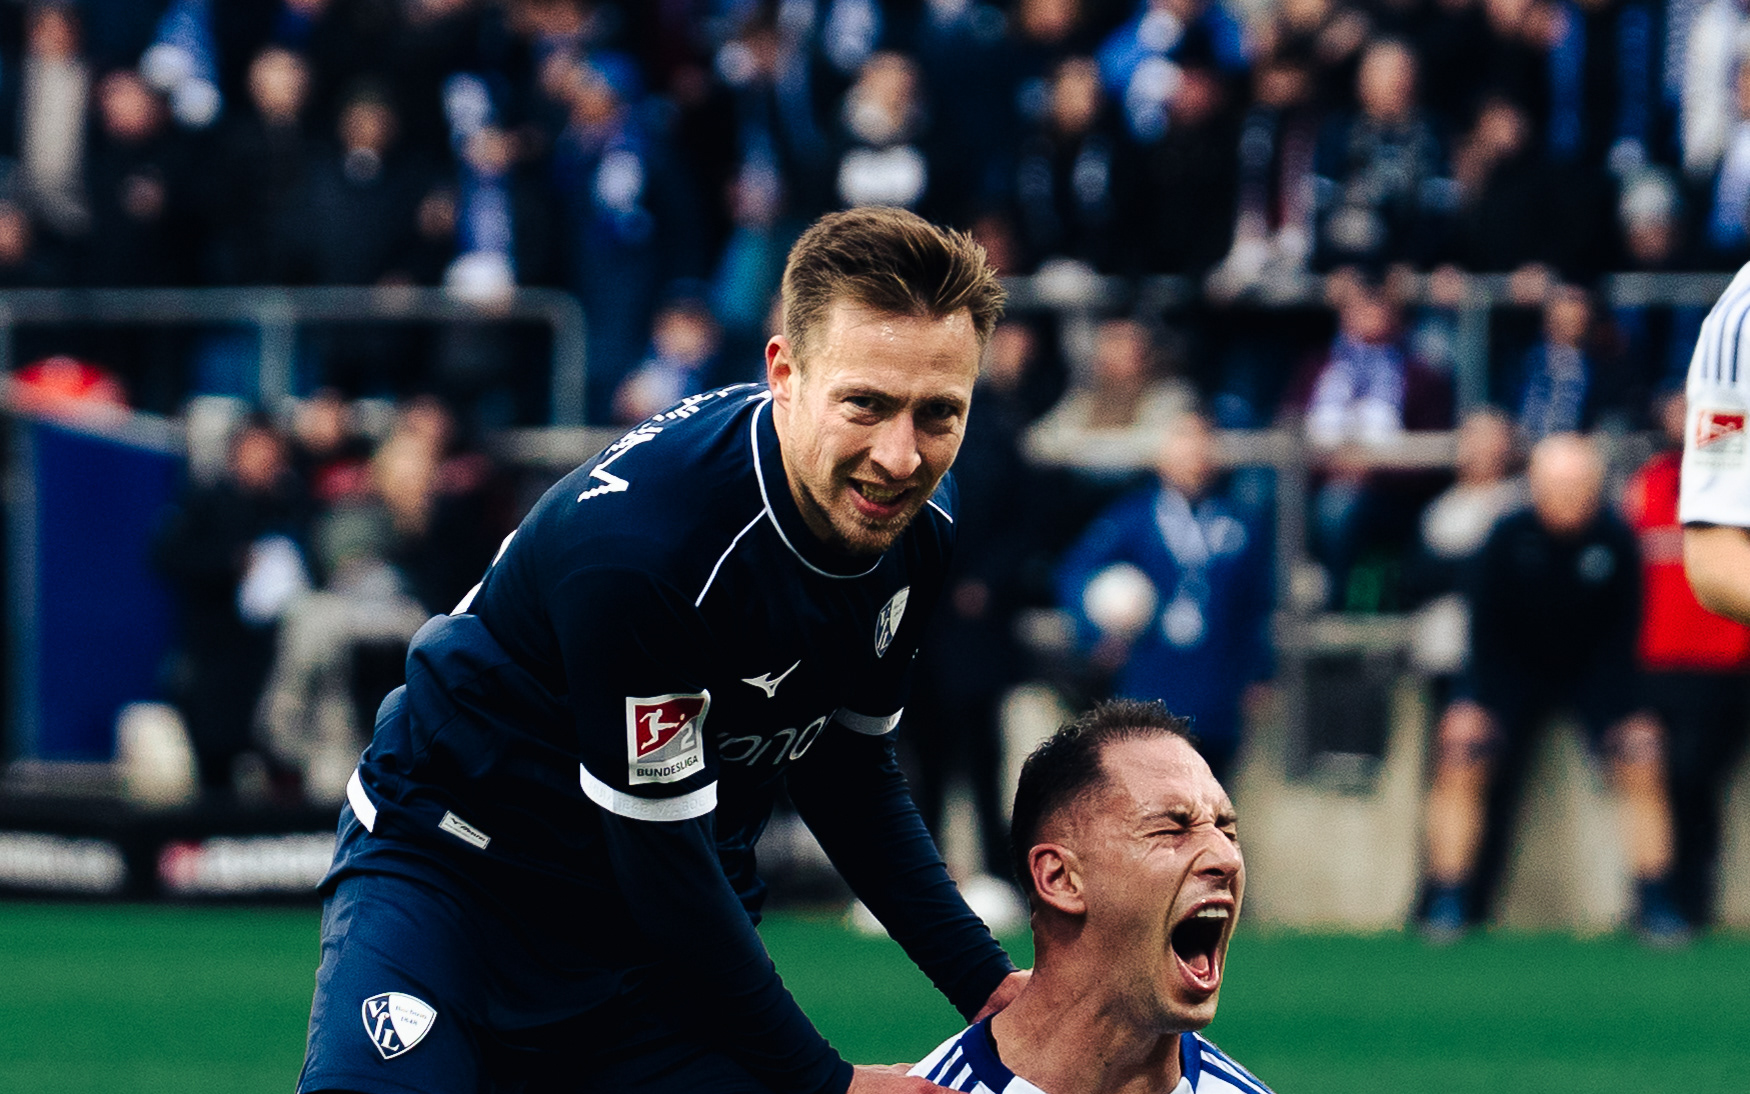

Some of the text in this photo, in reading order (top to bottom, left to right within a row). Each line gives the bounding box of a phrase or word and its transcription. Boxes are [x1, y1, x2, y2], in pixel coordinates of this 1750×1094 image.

[680, 722, 696, 751] 2
[636, 754, 700, 777] BUNDESLIGA
[367, 1000, 400, 1052] VfL
